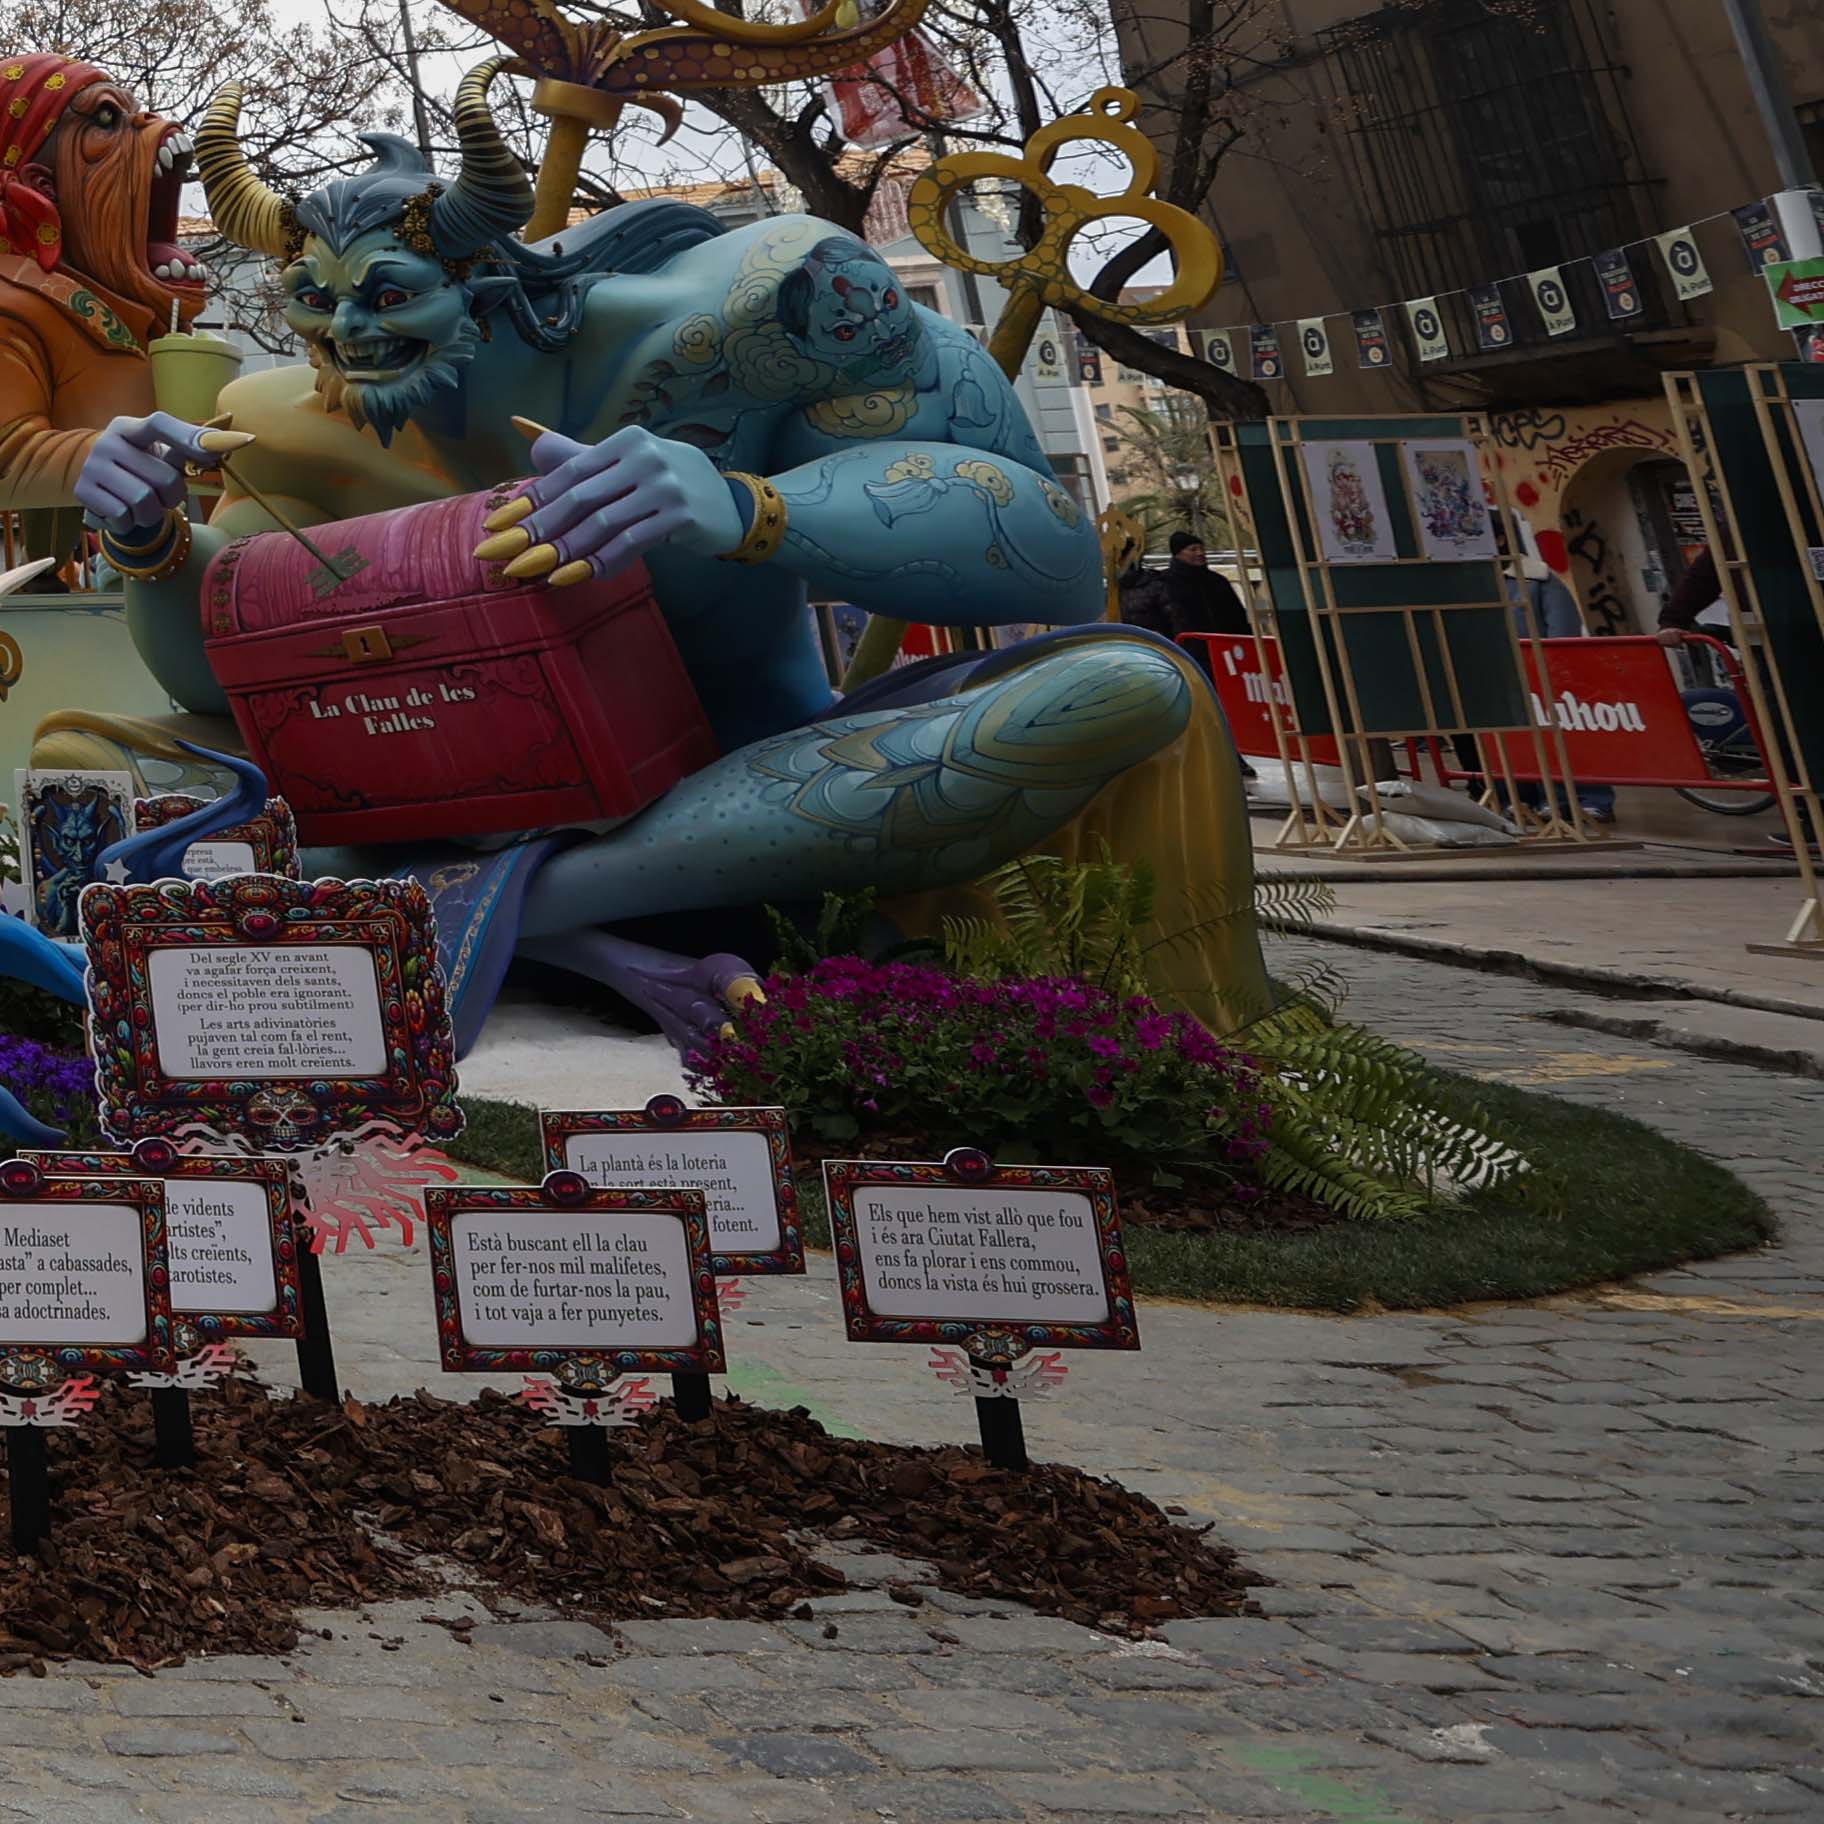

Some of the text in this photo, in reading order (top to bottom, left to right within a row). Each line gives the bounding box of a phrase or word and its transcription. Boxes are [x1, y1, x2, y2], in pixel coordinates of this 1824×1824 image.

[309, 683, 476, 719] La Clau de les
[1530, 691, 1646, 732] ahou
[363, 712, 435, 736] Falles
[190, 953, 212, 964] Del
[216, 952, 247, 967] segle
[250, 951, 271, 962] XV
[294, 953, 329, 962] avant
[204, 964, 242, 978] agafar
[245, 964, 276, 977] força
[184, 975, 341, 988] i necessitaven dels sants,
[177, 989, 213, 1000] doncs
[217, 988, 228, 999] el
[232, 988, 266, 1002] poble
[206, 999, 245, 1011] dir-ho
[248, 1003, 278, 1014] prou
[200, 1017, 336, 1030] Les arts adivinatòries
[188, 1029, 352, 1046] pujaven tal com fa el rent,
[197, 1044, 208, 1056] la
[212, 1046, 240, 1060] gent
[244, 1044, 275, 1055] creia
[190, 1056, 356, 1069] llavors eren molt creïents.
[579, 1153, 727, 1178] La plantà és la loteria
[182, 1197, 234, 1216] vidents
[712, 1215, 759, 1232] fotent.
[868, 1203, 1083, 1232] Els que hem vist allò que fou
[4, 1227, 70, 1247] Mediaset
[468, 1232, 648, 1252] Està buscant ell la clau
[872, 1226, 1038, 1251] i és ara Ciutat Fallera,
[37, 1258, 45, 1271] a
[49, 1253, 132, 1275] cabassades,
[191, 1244, 252, 1264] creïents,
[875, 1249, 1080, 1275] ens fa plorar i ens commou,
[470, 1255, 666, 1280] per fer-nos mil malifetes,
[25, 1277, 97, 1302] complet...
[472, 1278, 670, 1304] com de furtar-nos la pau,
[878, 1270, 1099, 1300] doncs la vista és hui grossera.
[14, 1299, 110, 1320] adoctrinades.
[475, 1302, 663, 1327] i tot vaja a fer punyetes.
